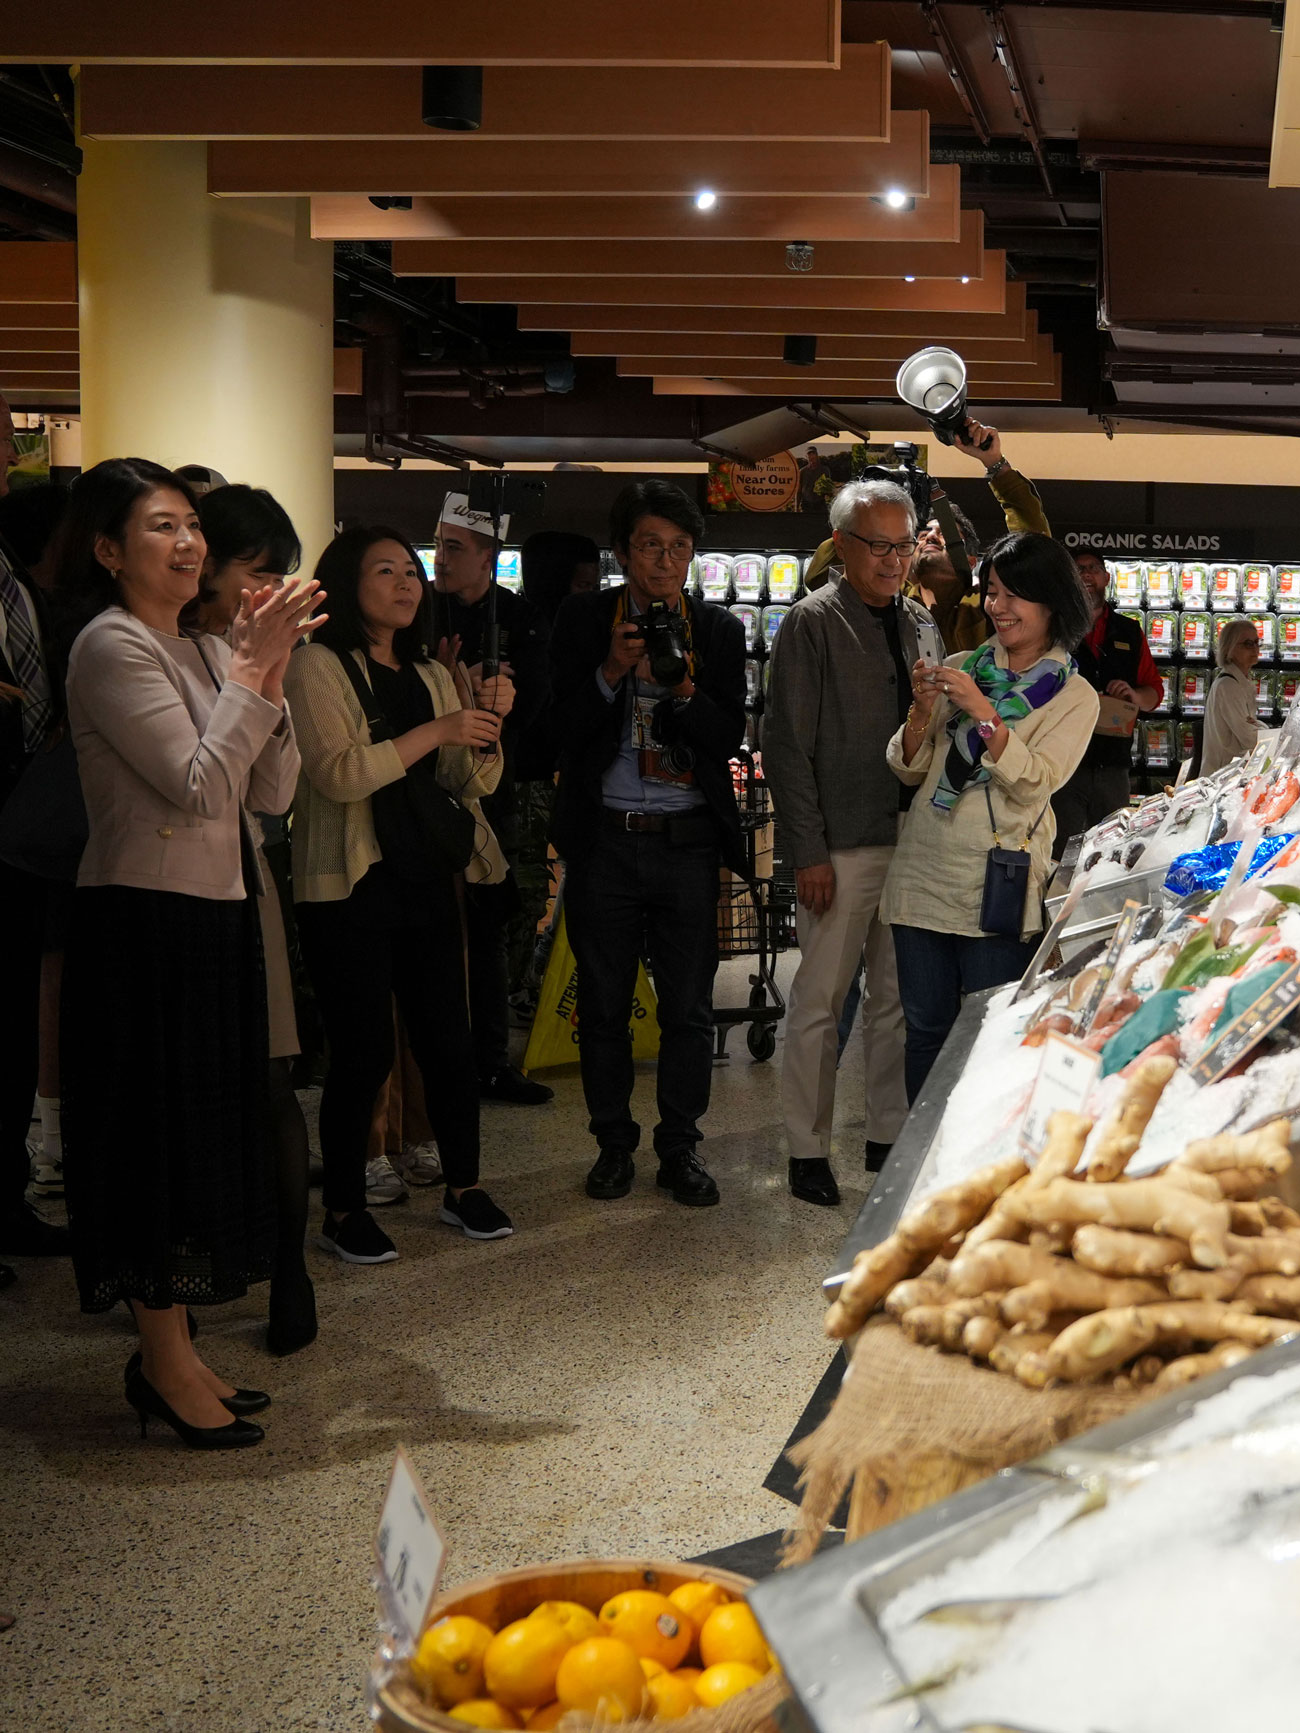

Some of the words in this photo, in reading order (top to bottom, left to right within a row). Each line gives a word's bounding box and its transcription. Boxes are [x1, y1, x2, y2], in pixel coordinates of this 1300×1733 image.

[766, 464, 790, 472] farms
[736, 474, 766, 484] Near
[768, 474, 793, 485] Our
[743, 486, 785, 495] Stores
[452, 504, 505, 526] Wegm
[1064, 532, 1147, 549] ORGANIC
[1152, 534, 1220, 551] SALADS
